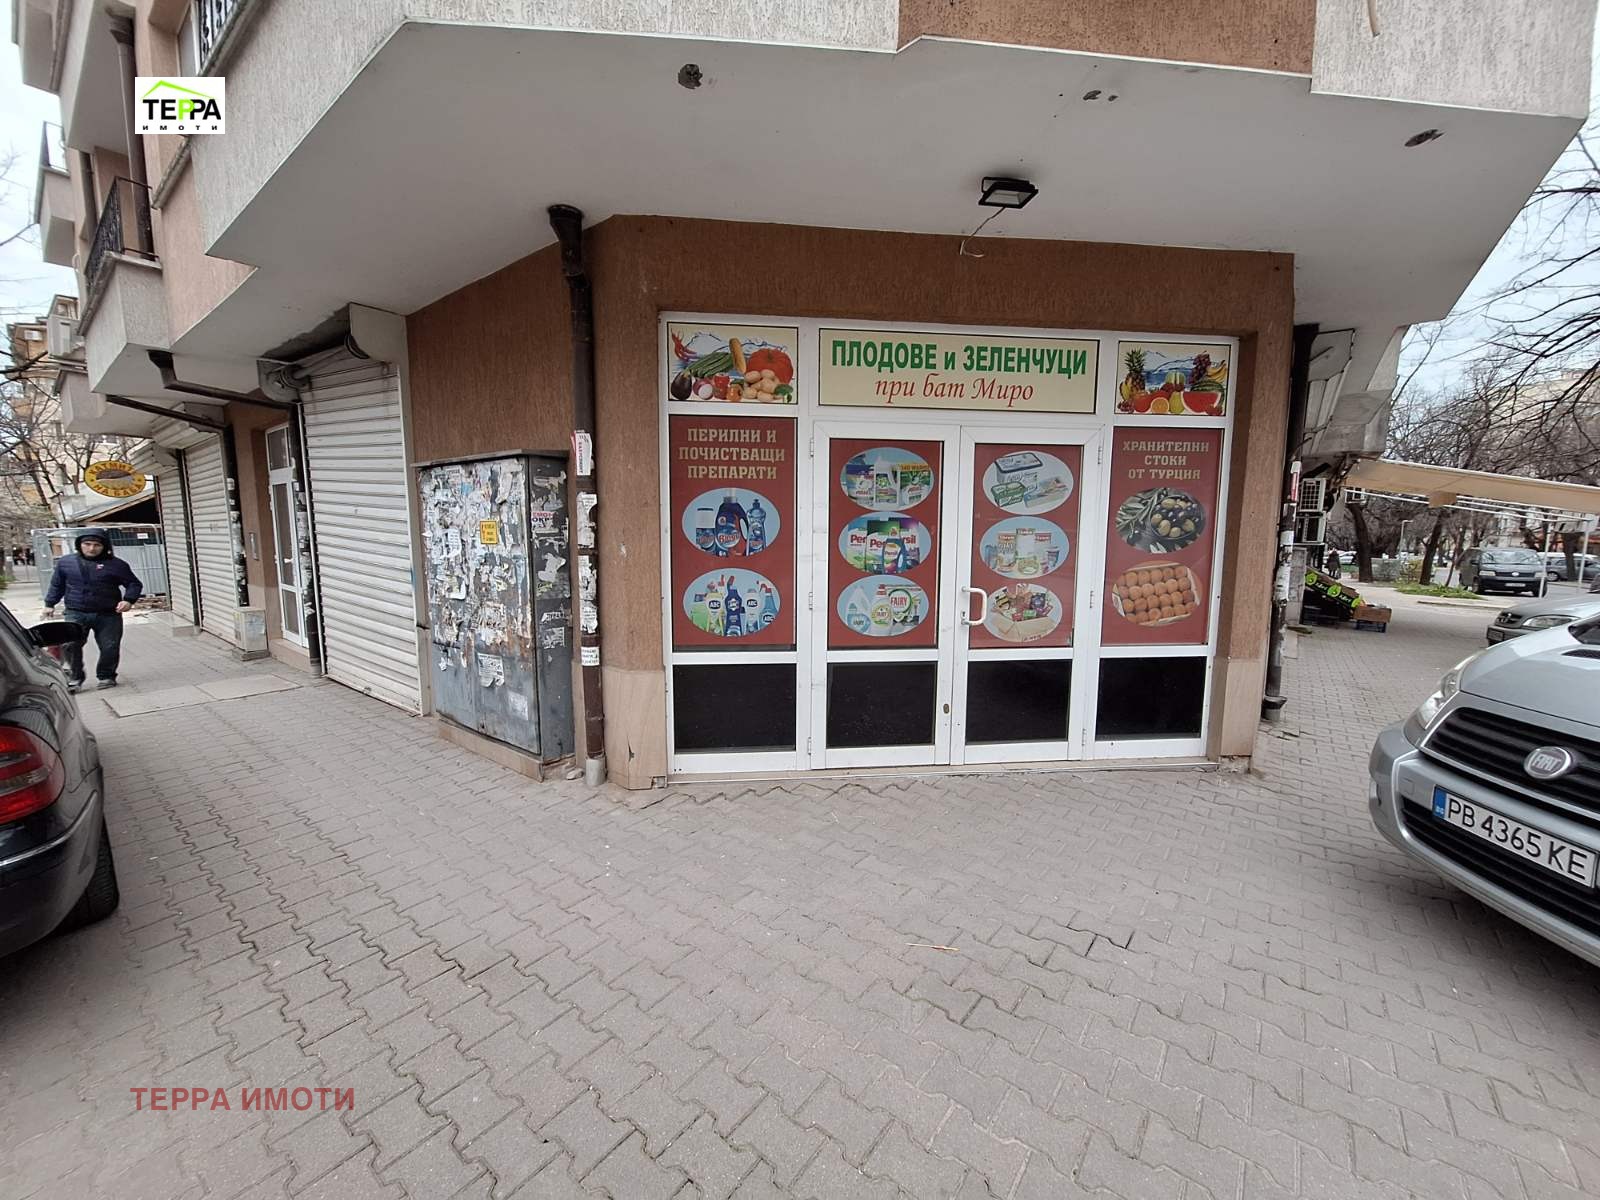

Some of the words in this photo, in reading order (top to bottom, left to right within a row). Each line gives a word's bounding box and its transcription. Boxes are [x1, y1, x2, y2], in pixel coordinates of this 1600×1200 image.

[832, 339, 938, 373] ПЛОДОВЕ
[944, 351, 956, 370] и
[963, 345, 1087, 379] ЗЕЛЕНЧУЦИ
[875, 379, 915, 403] при
[923, 372, 965, 399] бат
[972, 376, 1034, 407] Миро
[687, 428, 760, 443] ПЕРИЛНИ
[766, 429, 777, 443] И
[1122, 441, 1209, 453] ХРАНИТЕЛНИ
[679, 446, 785, 464] ПОЧИСТВАЩИ
[1144, 455, 1187, 466] СТОКИ
[687, 465, 777, 480] ПРЕПАРАТИ
[1128, 468, 1145, 479] ОТ
[1149, 468, 1201, 480] ТУРЦИЯ
[1531, 754, 1562, 770] FIAT
[1448, 798, 1476, 828] PB
[1481, 815, 1541, 858] 4365
[1548, 840, 1587, 881] KE
